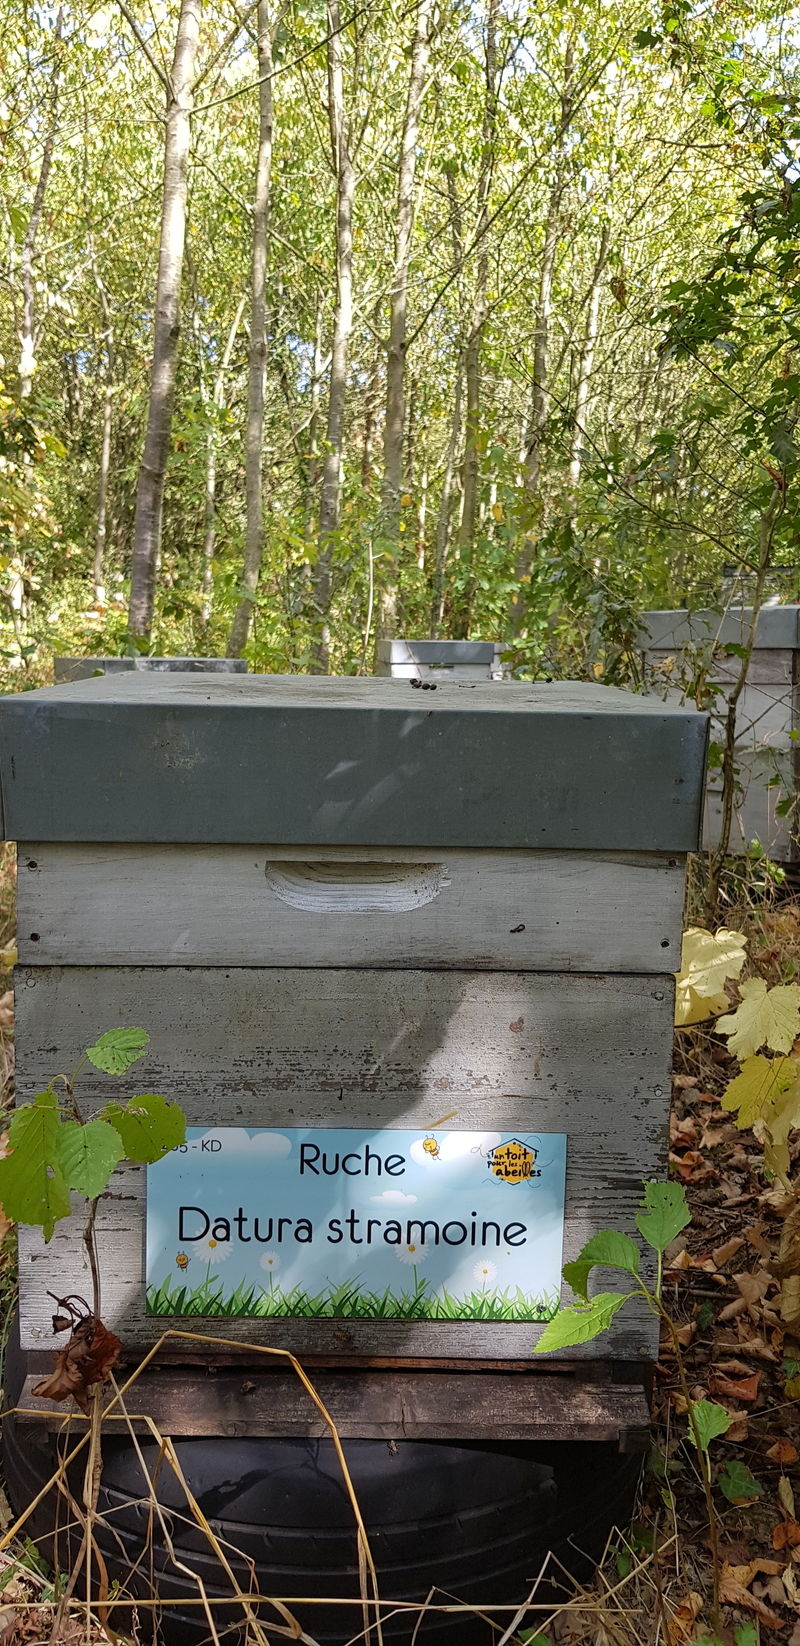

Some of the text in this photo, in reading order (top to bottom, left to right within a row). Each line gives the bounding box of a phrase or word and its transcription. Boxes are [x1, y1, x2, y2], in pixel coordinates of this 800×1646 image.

[201, 1139, 222, 1152] KD
[299, 1143, 407, 1177] Ruche
[505, 1147, 530, 1160] toit
[487, 1160, 518, 1169] pour les
[495, 1161, 542, 1178] abeilles
[178, 1206, 528, 1248] Datura stramoine
